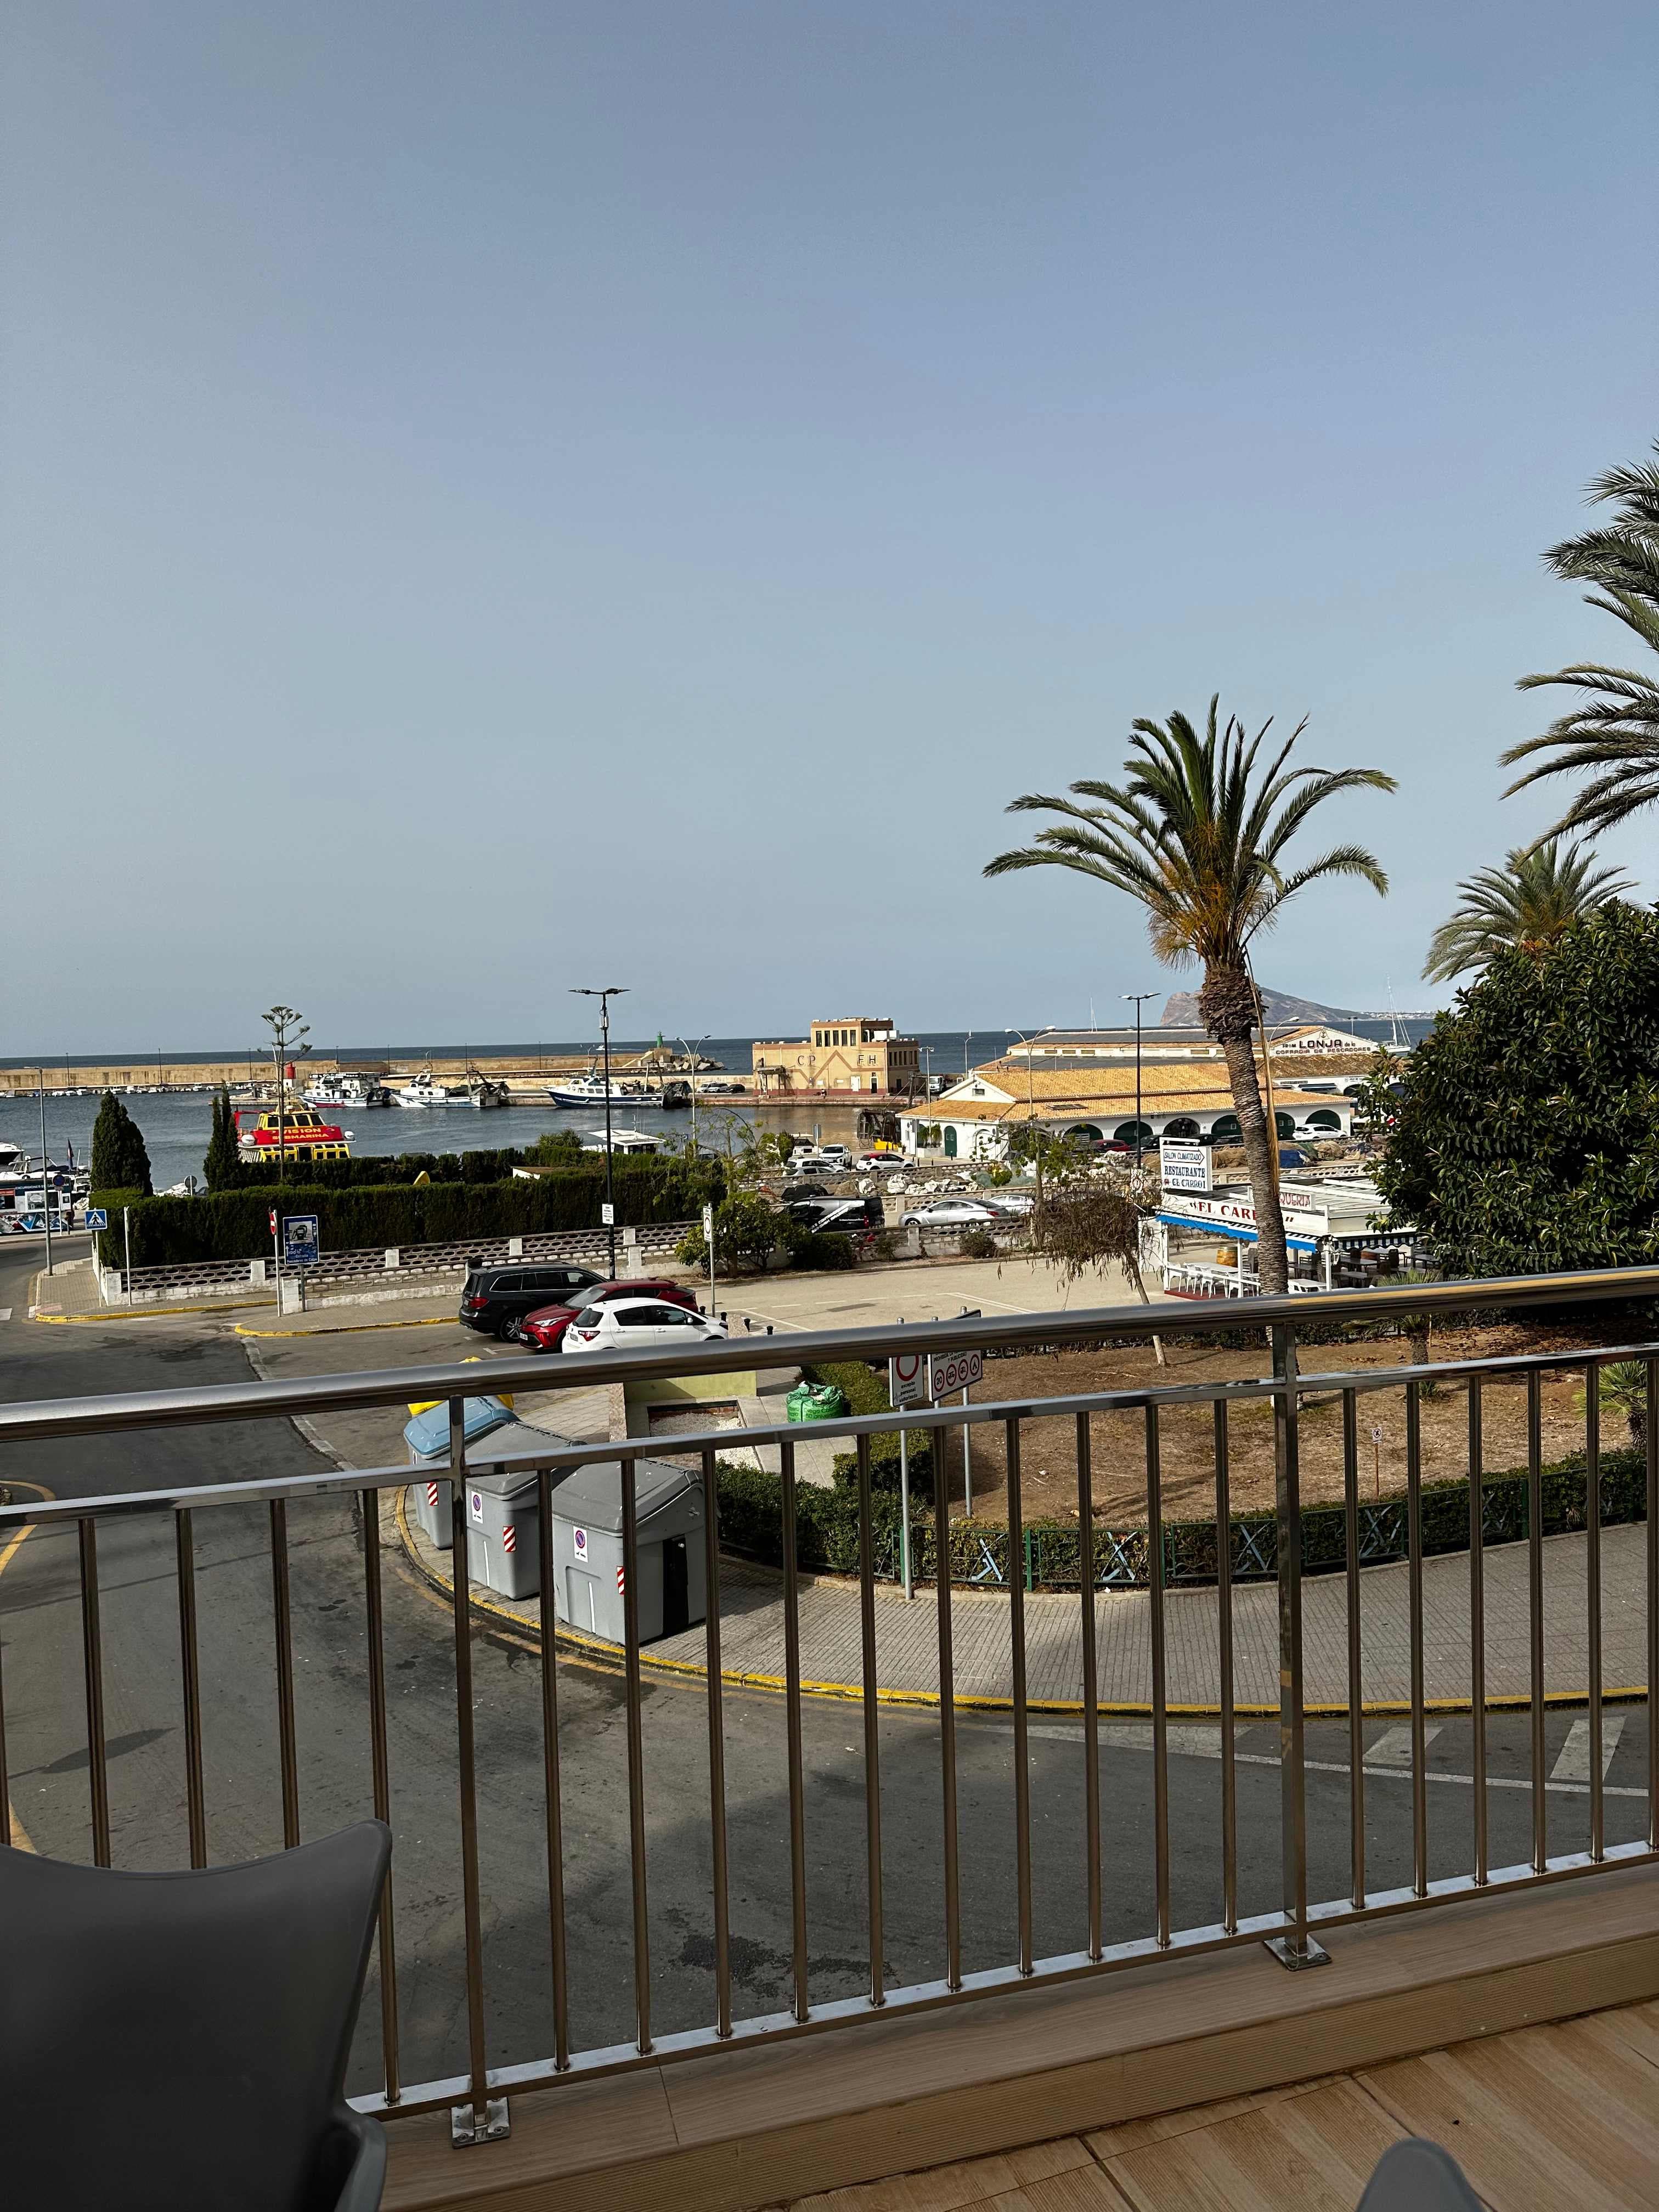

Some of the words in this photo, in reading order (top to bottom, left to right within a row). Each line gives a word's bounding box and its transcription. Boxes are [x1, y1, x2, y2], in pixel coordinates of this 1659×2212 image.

[1299, 1039, 1342, 1048] LONJA
[1164, 1166, 1205, 1178] RESTAURANTE
[1279, 1192, 1311, 1207] QUERIA
[936, 1376, 943, 1385] 20
